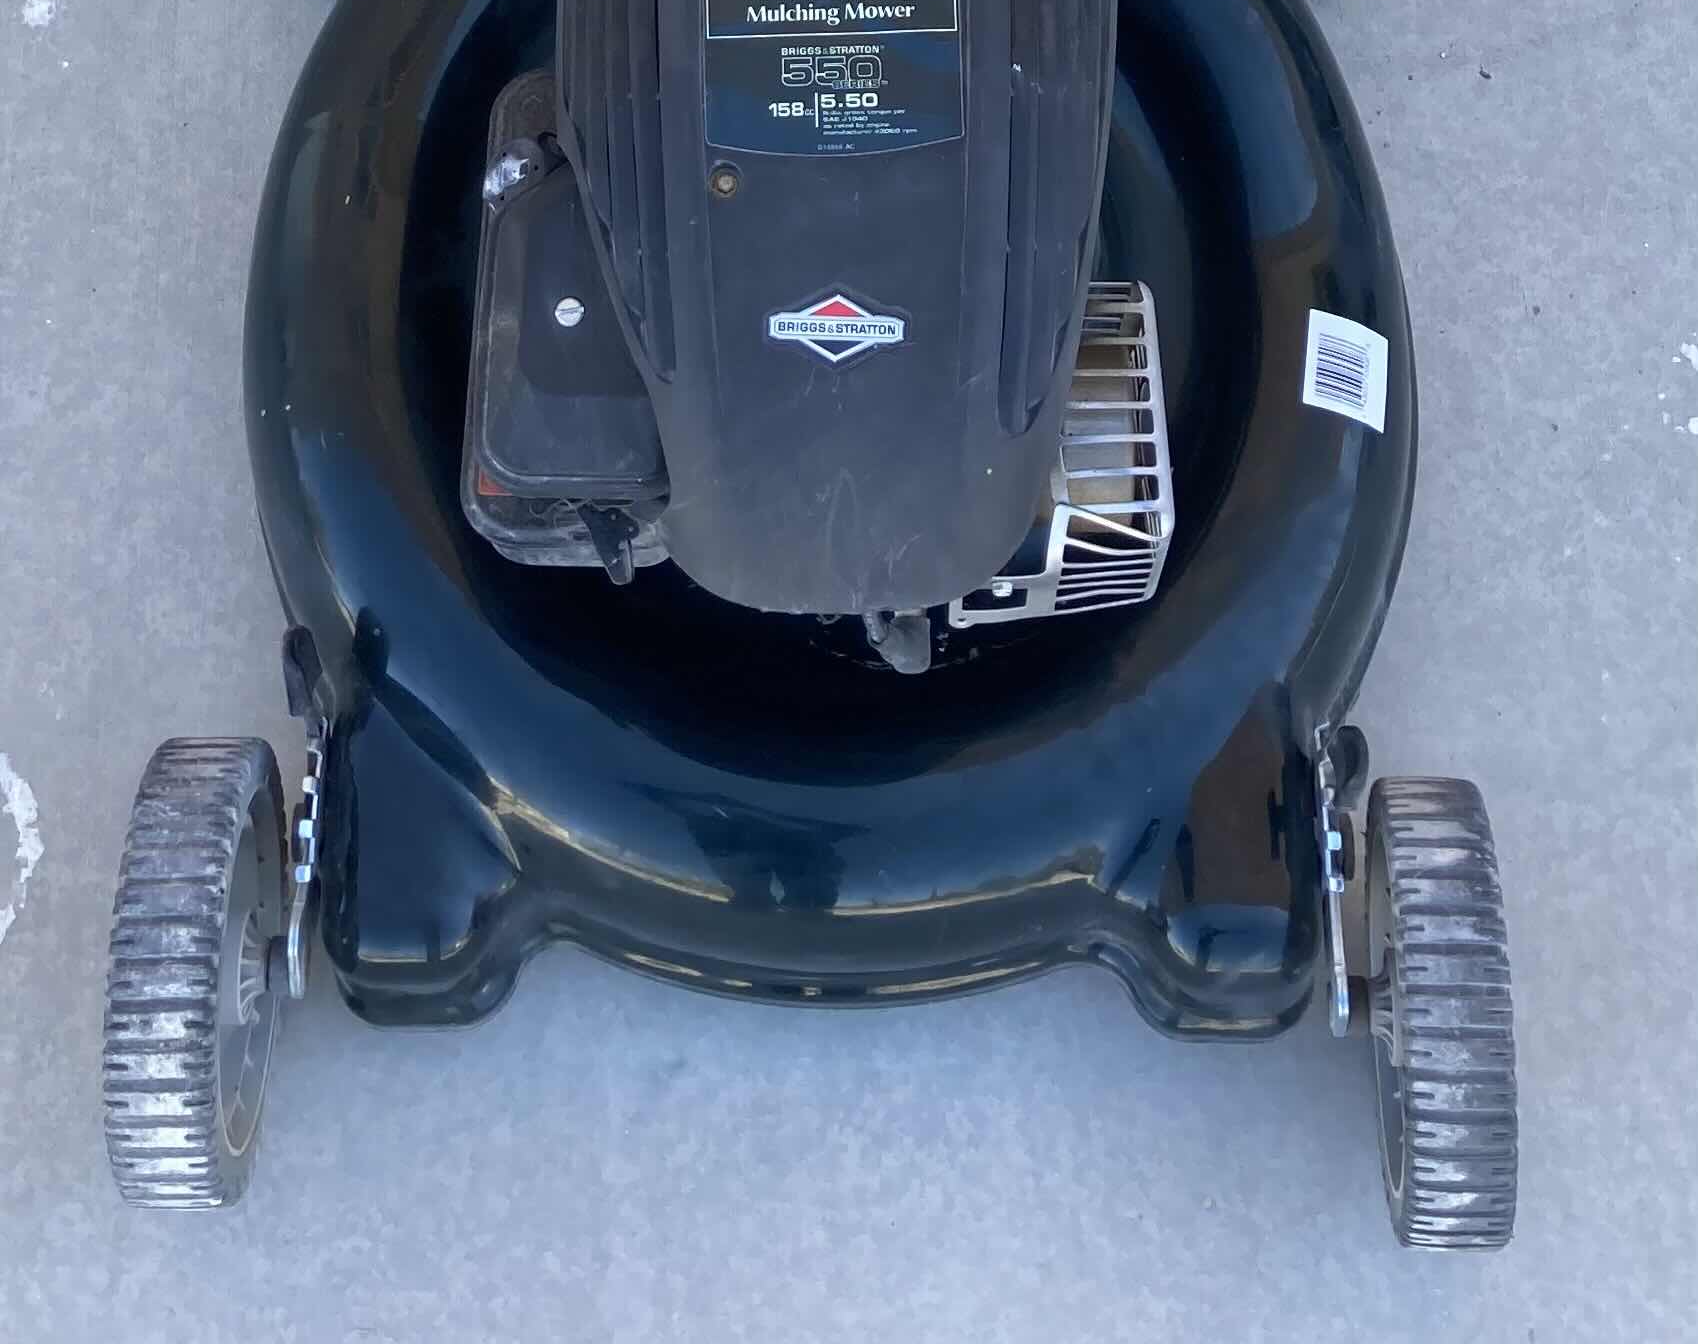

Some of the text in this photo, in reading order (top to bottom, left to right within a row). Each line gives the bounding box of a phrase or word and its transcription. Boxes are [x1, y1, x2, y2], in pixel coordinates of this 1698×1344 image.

[746, 3, 915, 25] Mulching Mower
[781, 55, 882, 87] 550
[820, 93, 879, 108] 5.50
